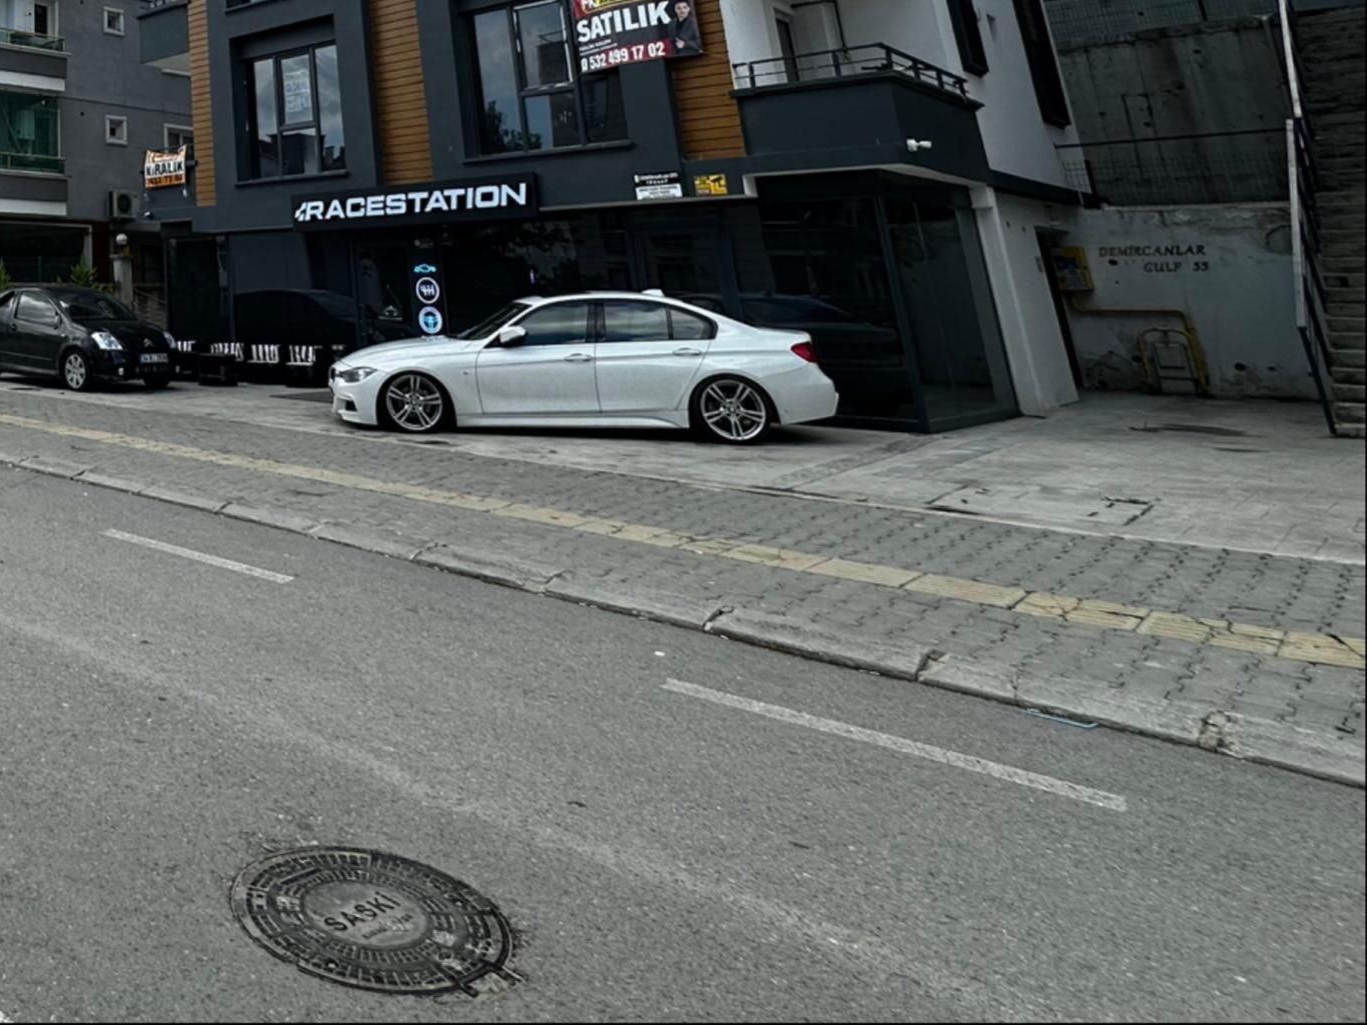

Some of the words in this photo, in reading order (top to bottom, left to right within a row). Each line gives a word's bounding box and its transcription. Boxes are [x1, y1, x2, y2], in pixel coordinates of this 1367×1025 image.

[576, 0, 672, 43] SATILIK
[580, 57, 588, 73] 0
[589, 53, 608, 70] 532
[608, 47, 630, 65] 499
[631, 43, 645, 60] 17
[648, 40, 666, 57] 02
[303, 183, 527, 221] RACESTATION
[1144, 262, 1182, 272] GULF
